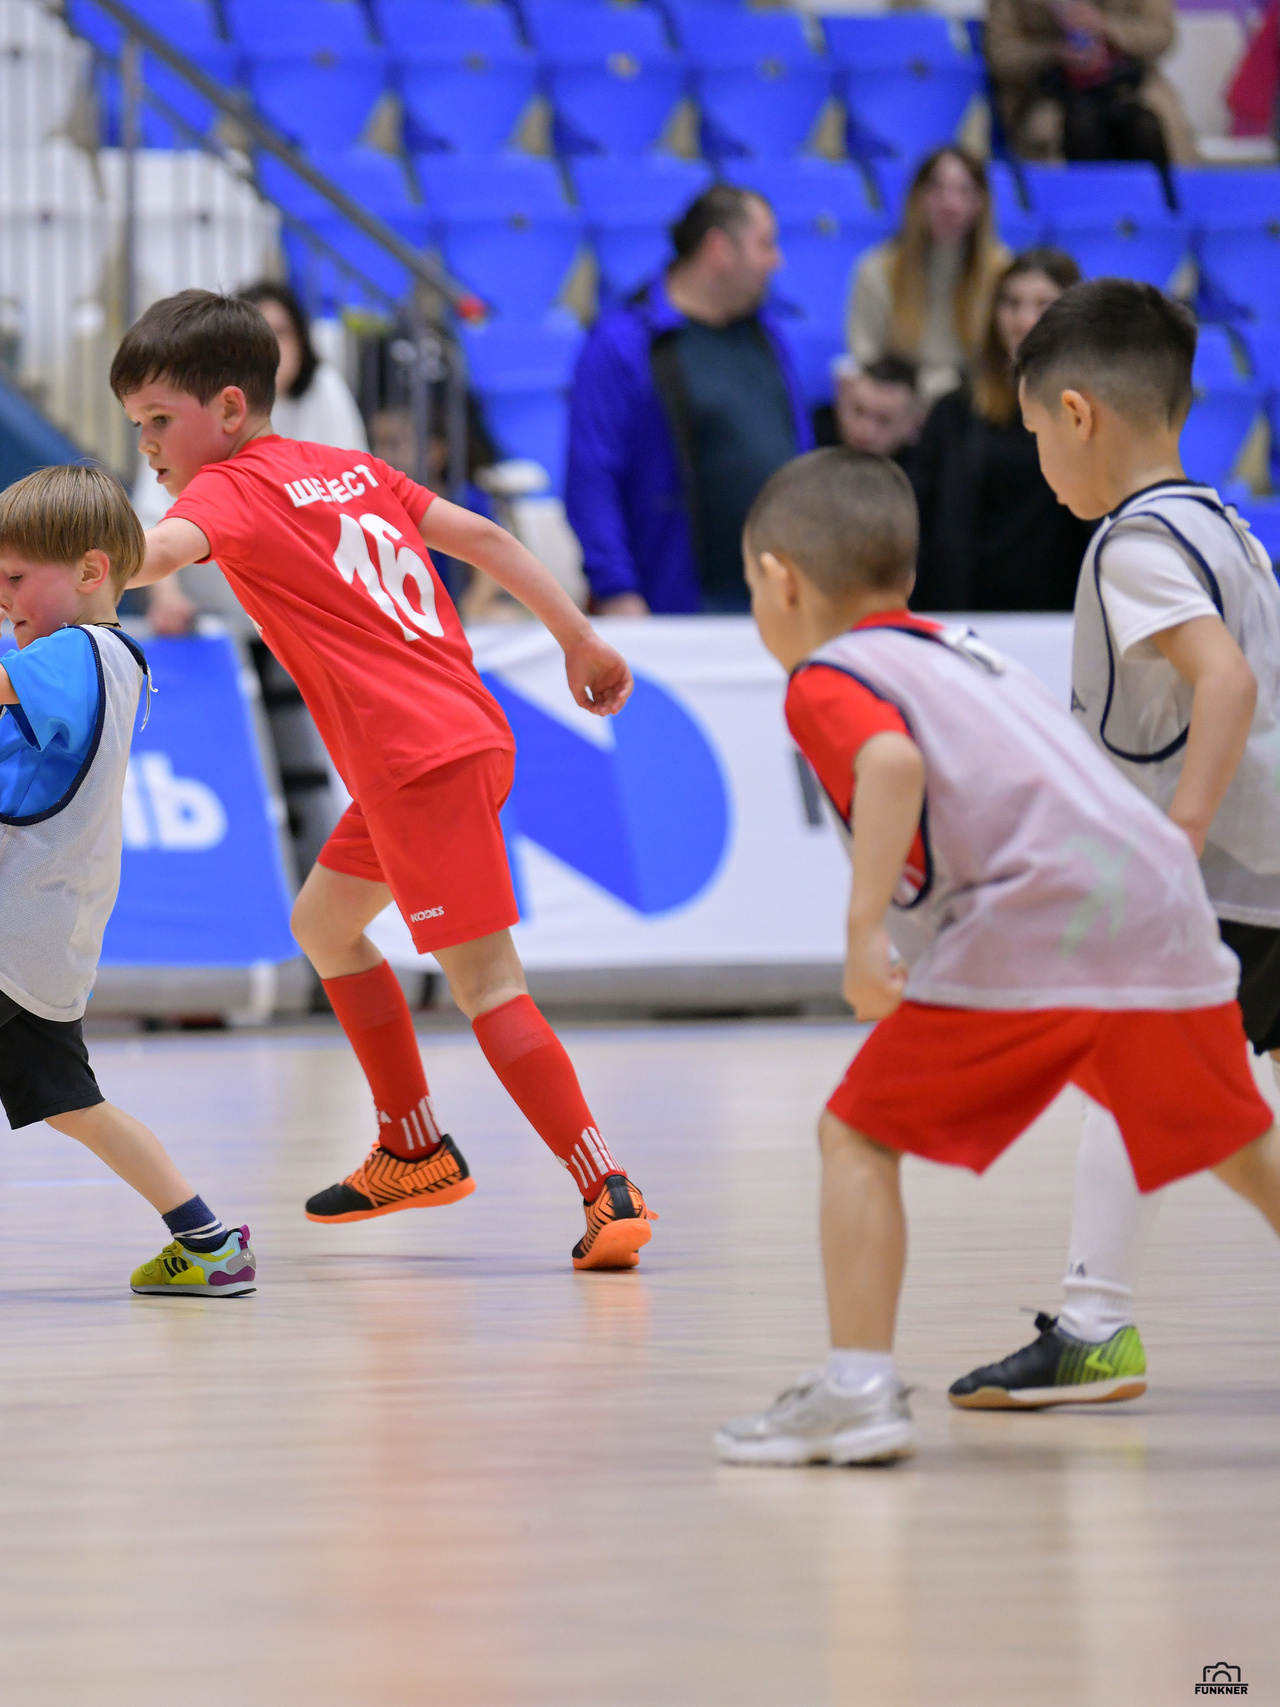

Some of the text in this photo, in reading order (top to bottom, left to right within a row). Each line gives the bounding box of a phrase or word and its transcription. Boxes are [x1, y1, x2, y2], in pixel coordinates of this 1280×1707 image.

[283, 464, 379, 508] ШЕЕСТ
[333, 513, 444, 642] 16
[410, 906, 445, 923] KODES
[399, 1153, 461, 1195] PUMA
